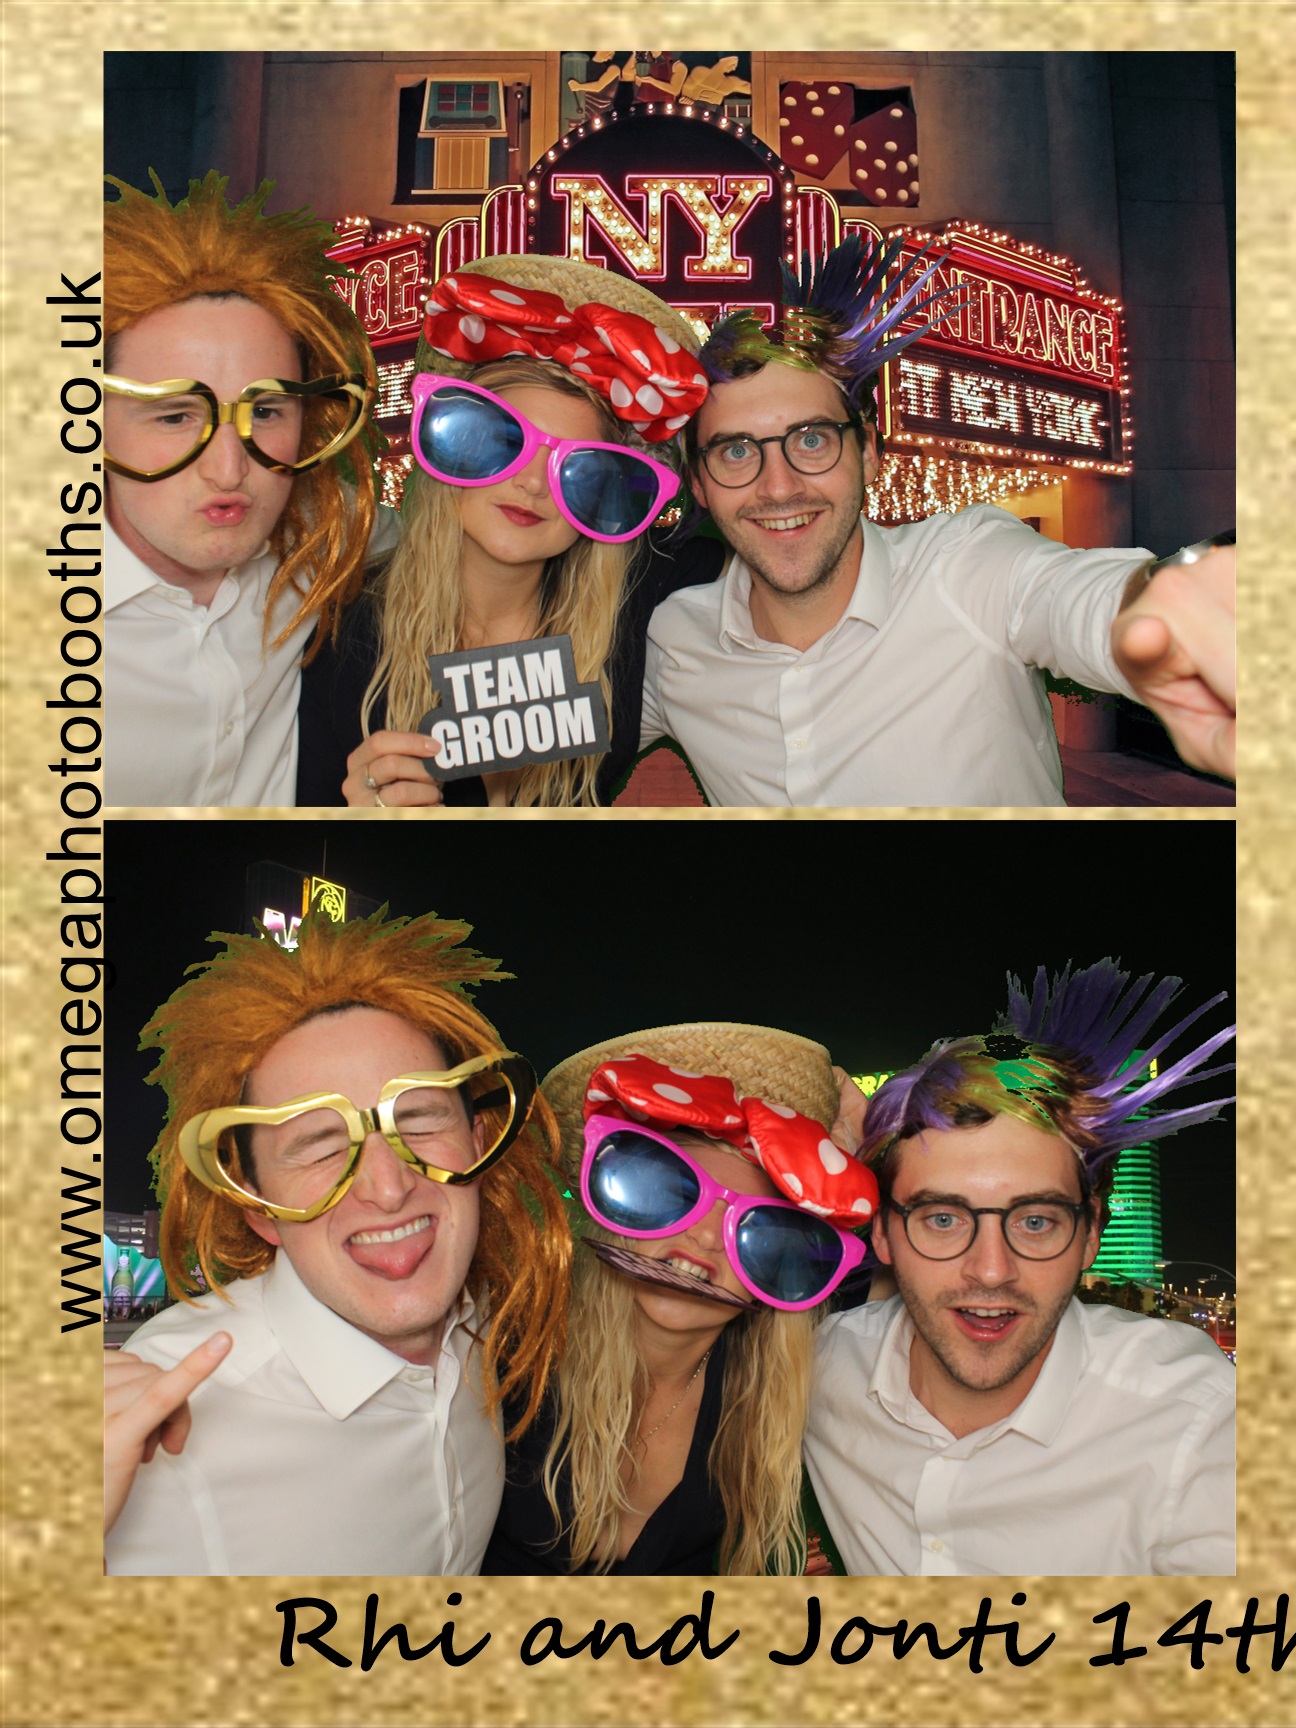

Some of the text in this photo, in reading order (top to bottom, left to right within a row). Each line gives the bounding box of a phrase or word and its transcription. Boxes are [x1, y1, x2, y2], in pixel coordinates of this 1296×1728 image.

[551, 173, 774, 281] NY
[899, 250, 1115, 378] ENTRANCE
[443, 648, 566, 713] TEAM
[431, 696, 596, 770] GROOM
